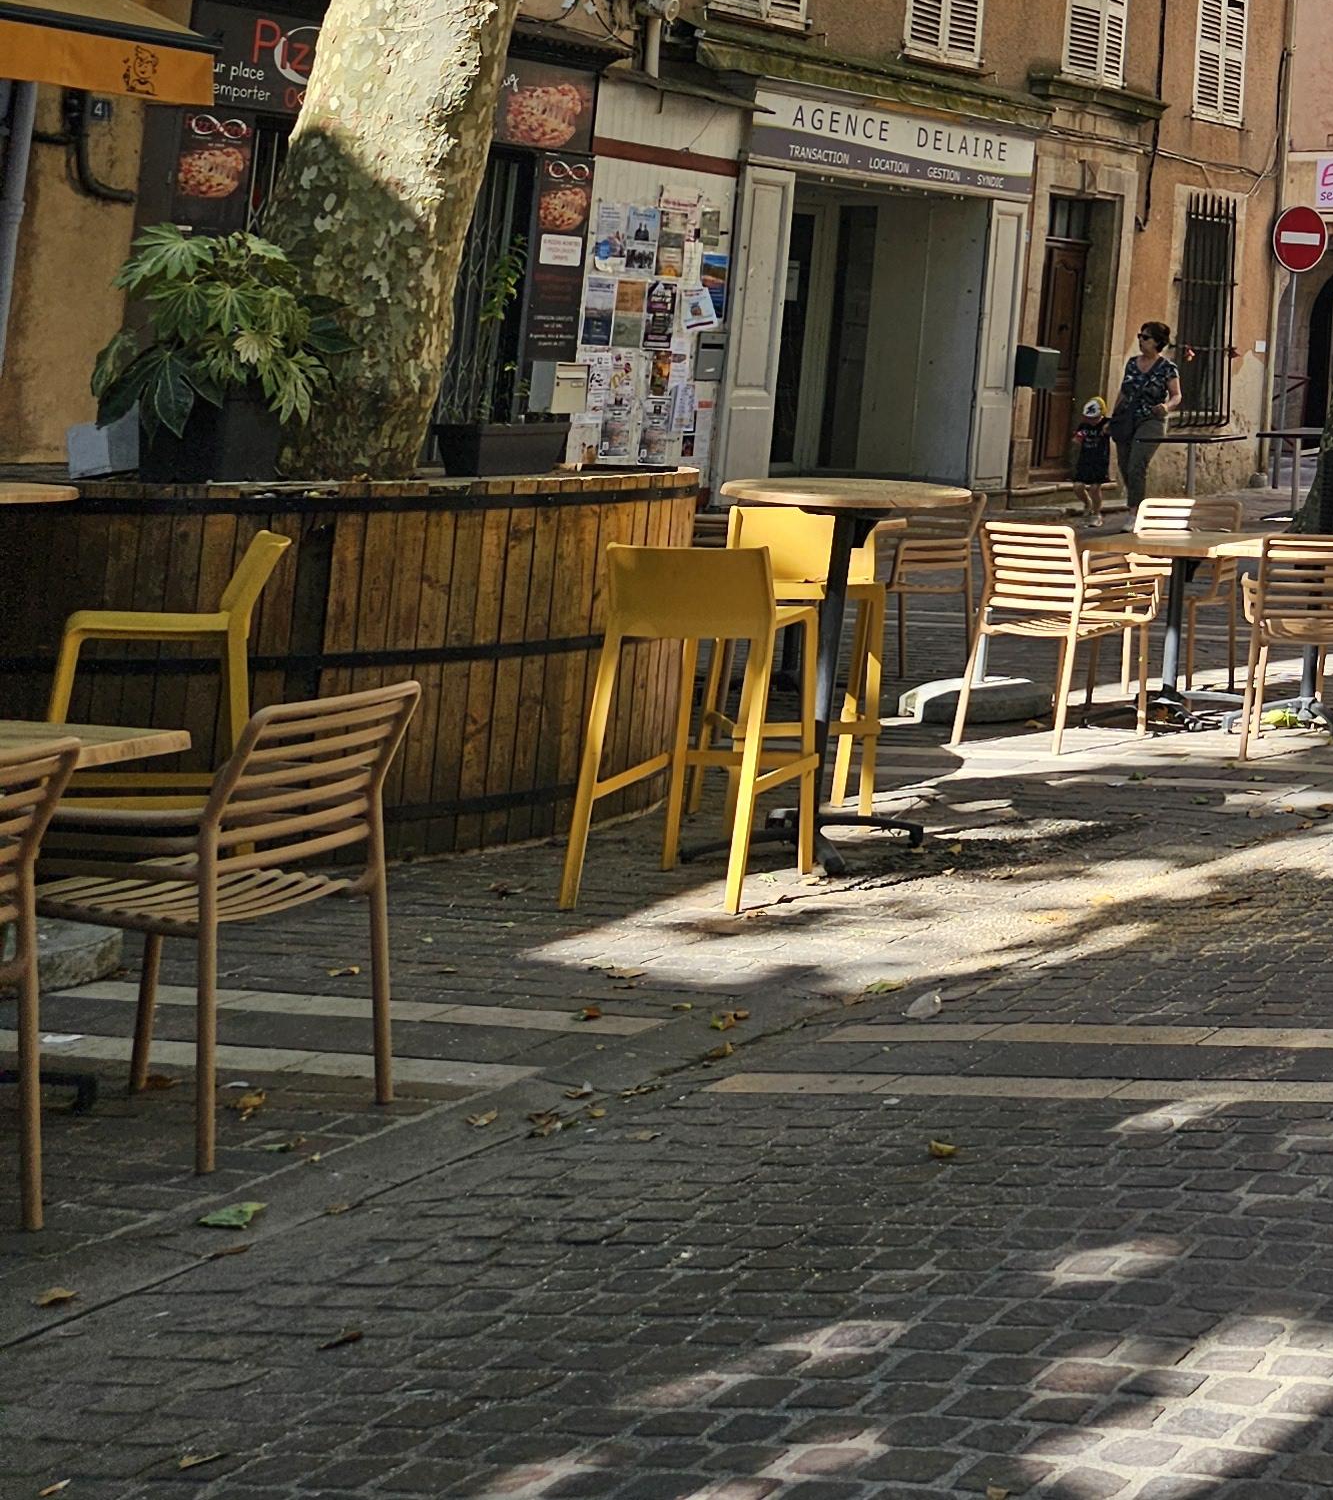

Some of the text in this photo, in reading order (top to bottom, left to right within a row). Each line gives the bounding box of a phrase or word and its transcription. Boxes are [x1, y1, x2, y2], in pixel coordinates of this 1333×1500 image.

[251, 18, 310, 71] Piz
[213, 61, 265, 81] ur place
[213, 83, 271, 102] emporter
[792, 105, 1008, 162] AGENCE DELAIRE
[788, 145, 1004, 188] TRANSACTION LOCATION GESTION SYNDIC
